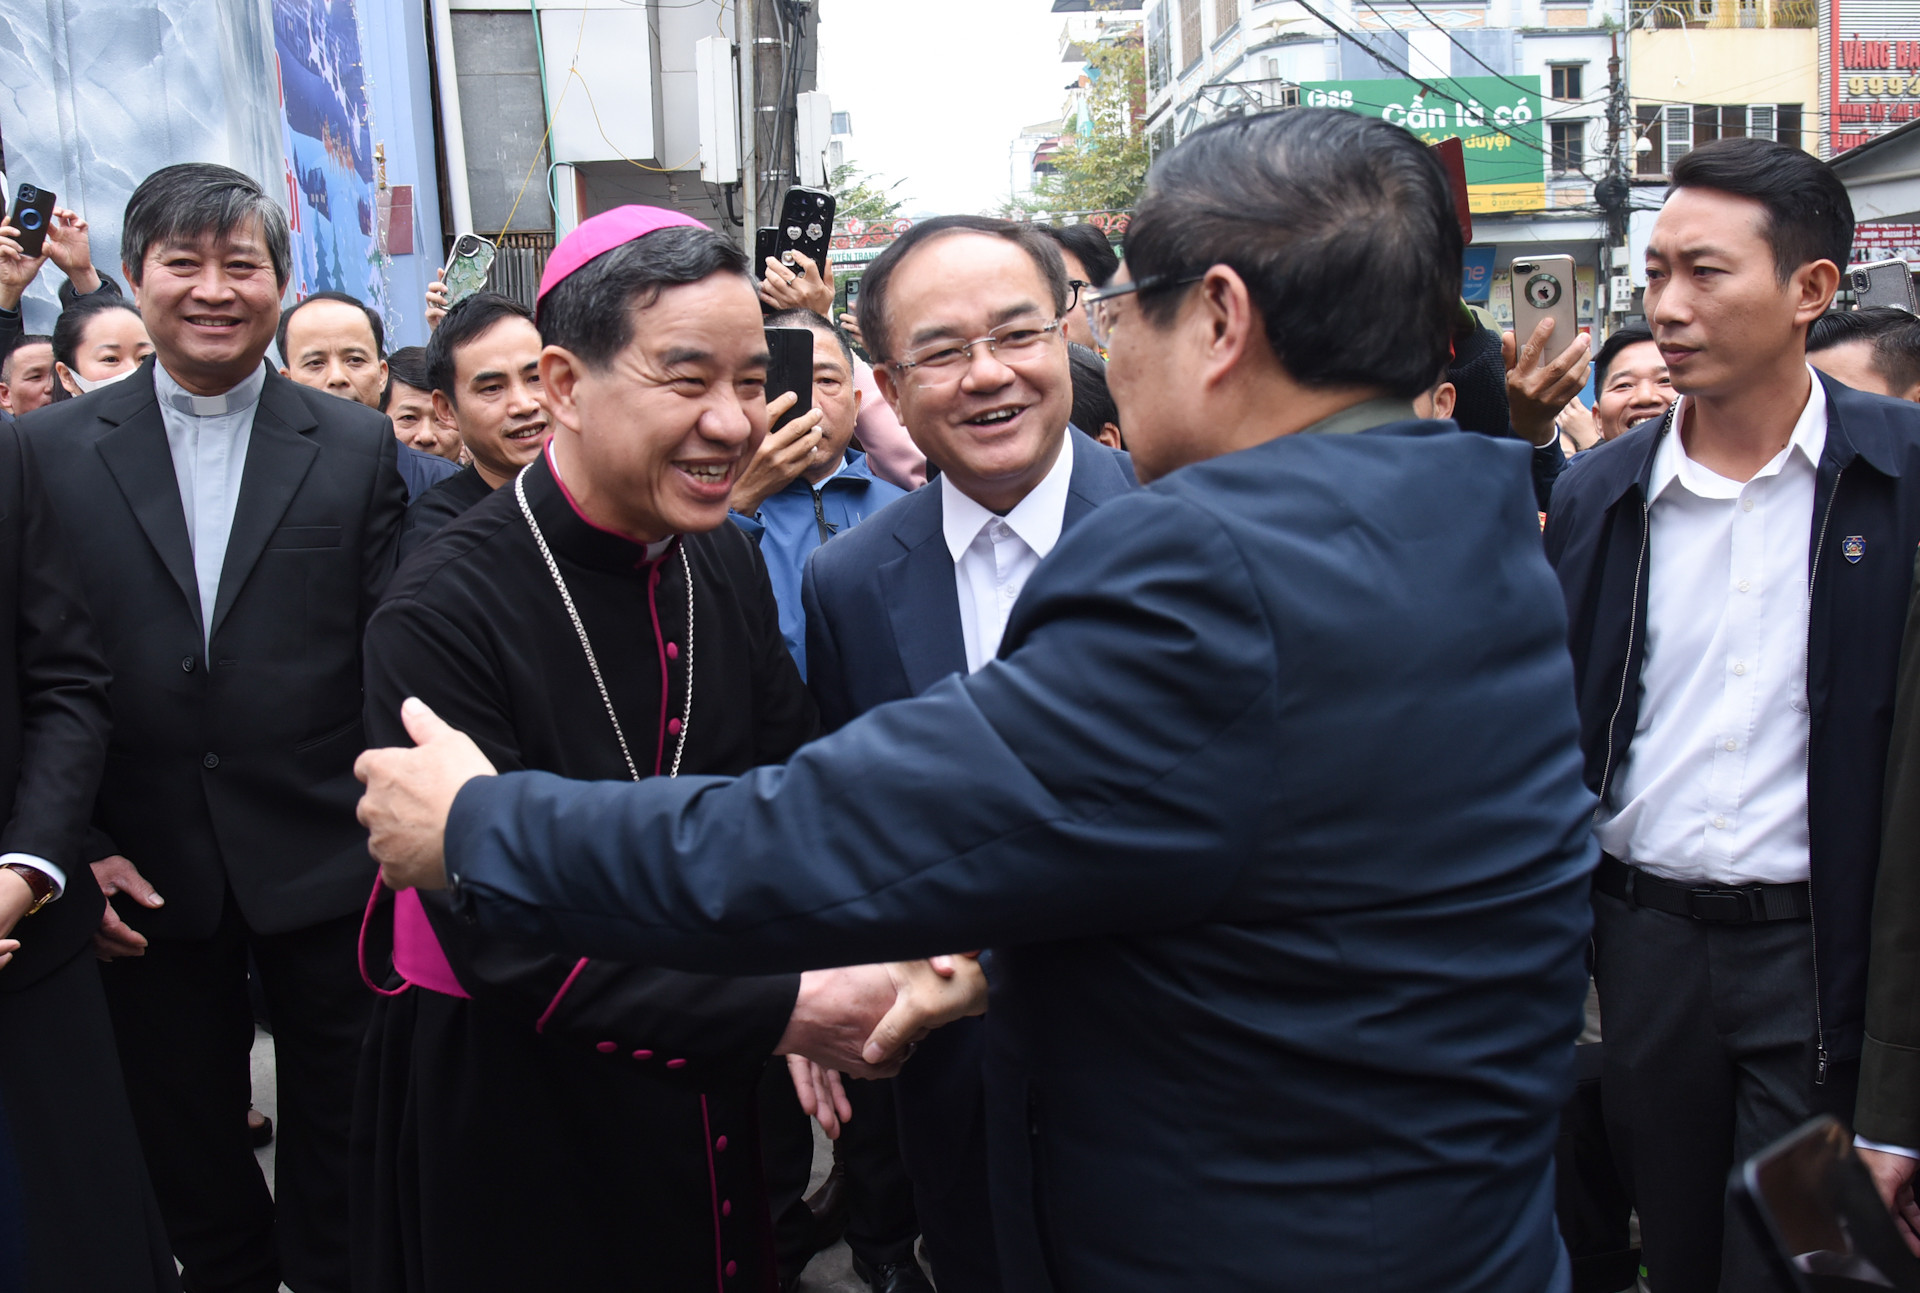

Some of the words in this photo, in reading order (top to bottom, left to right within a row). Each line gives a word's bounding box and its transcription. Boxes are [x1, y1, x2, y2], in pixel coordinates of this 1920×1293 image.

[1841, 33, 1890, 68] VÀNG
[1382, 94, 1447, 129] Cần
[1455, 98, 1485, 127] là
[1493, 96, 1533, 125] có
[1464, 131, 1512, 151] duyệt
